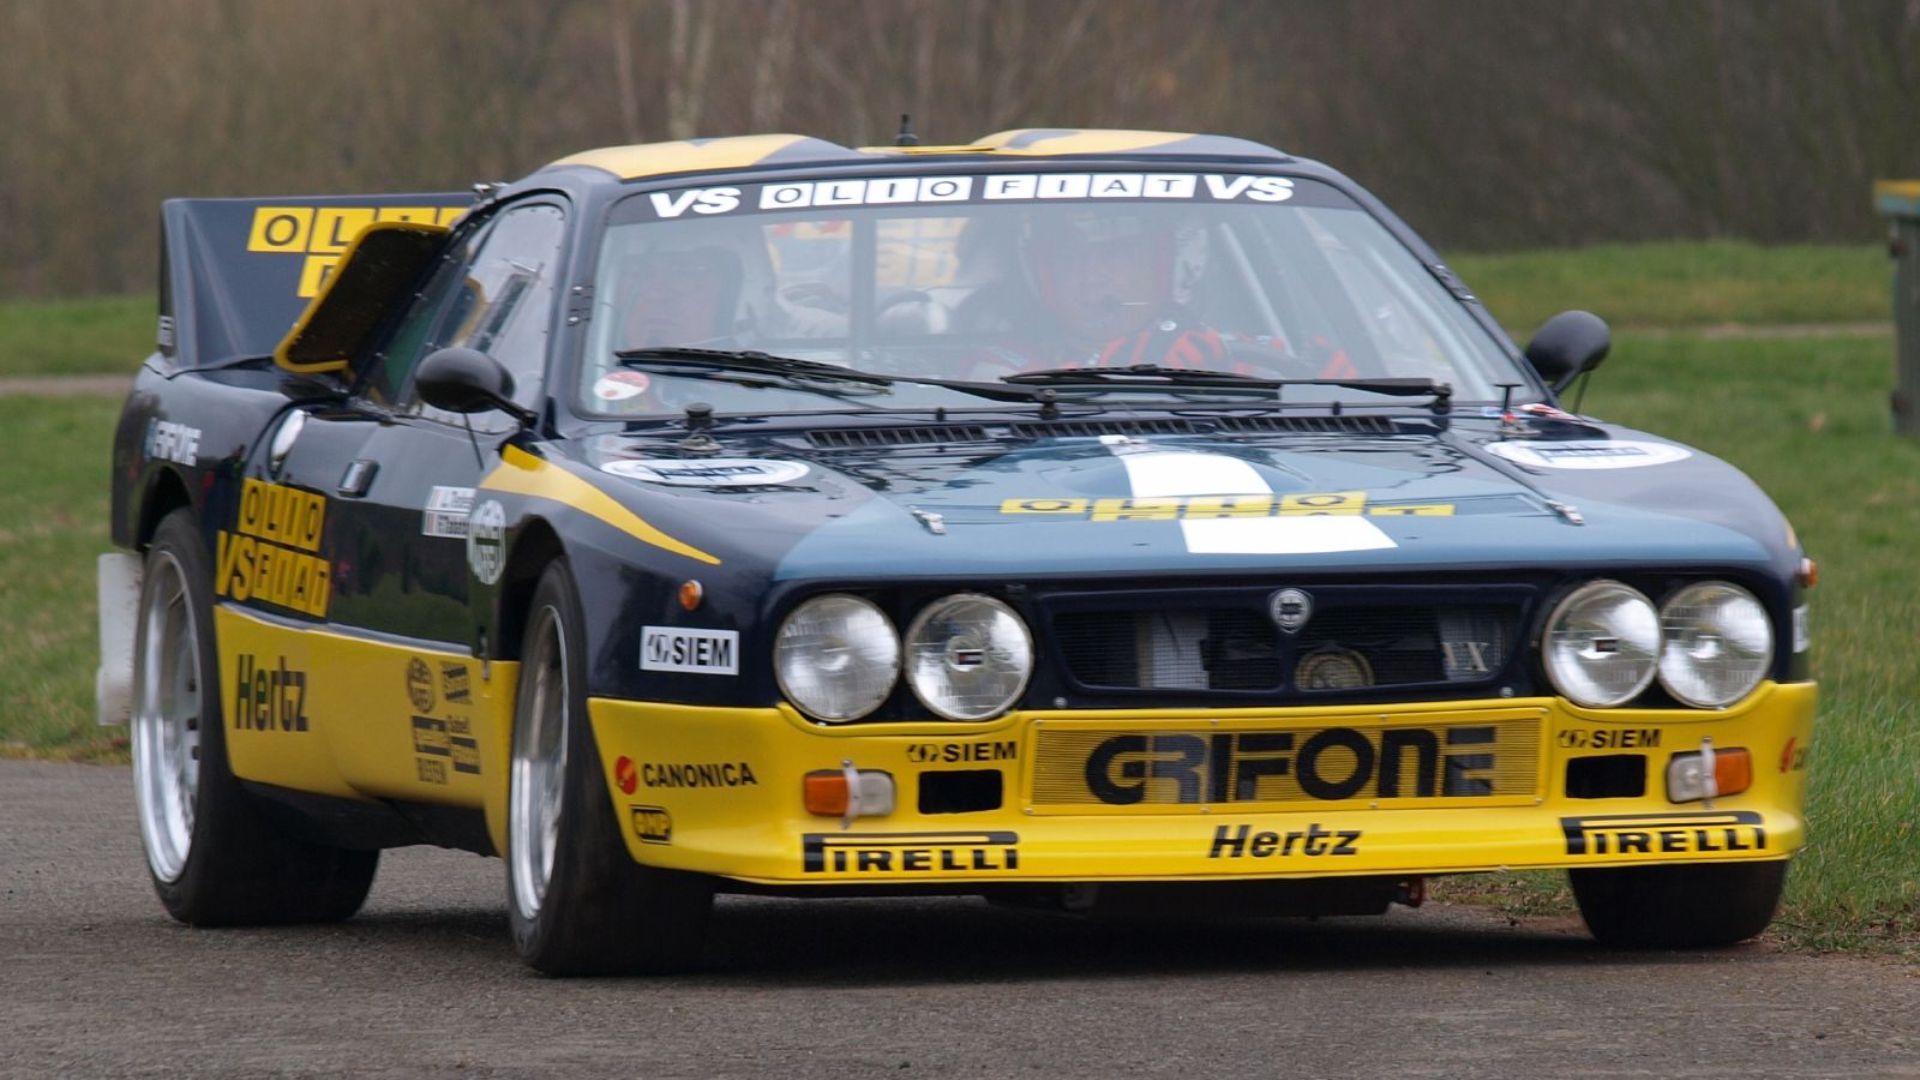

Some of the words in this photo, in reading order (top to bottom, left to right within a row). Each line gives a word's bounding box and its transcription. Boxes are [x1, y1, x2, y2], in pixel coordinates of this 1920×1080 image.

[650, 187, 742, 218] VS
[772, 180, 959, 205] OLIO
[998, 177, 1184, 196] FIAT
[1203, 174, 1294, 202] VS
[244, 485, 321, 542] OLIO
[215, 529, 256, 601] VS
[256, 552, 328, 609] FIAT
[672, 636, 732, 668] SIEM
[236, 653, 309, 732] Hertz
[943, 741, 1018, 762] SIEM
[1592, 729, 1662, 748] SIEM
[642, 763, 758, 788] CANONICA
[1083, 726, 1497, 805] GRIFONE
[803, 831, 1019, 872] PIRELLI
[1209, 824, 1363, 858] Hertz
[1560, 811, 1767, 855] PIRELLI
